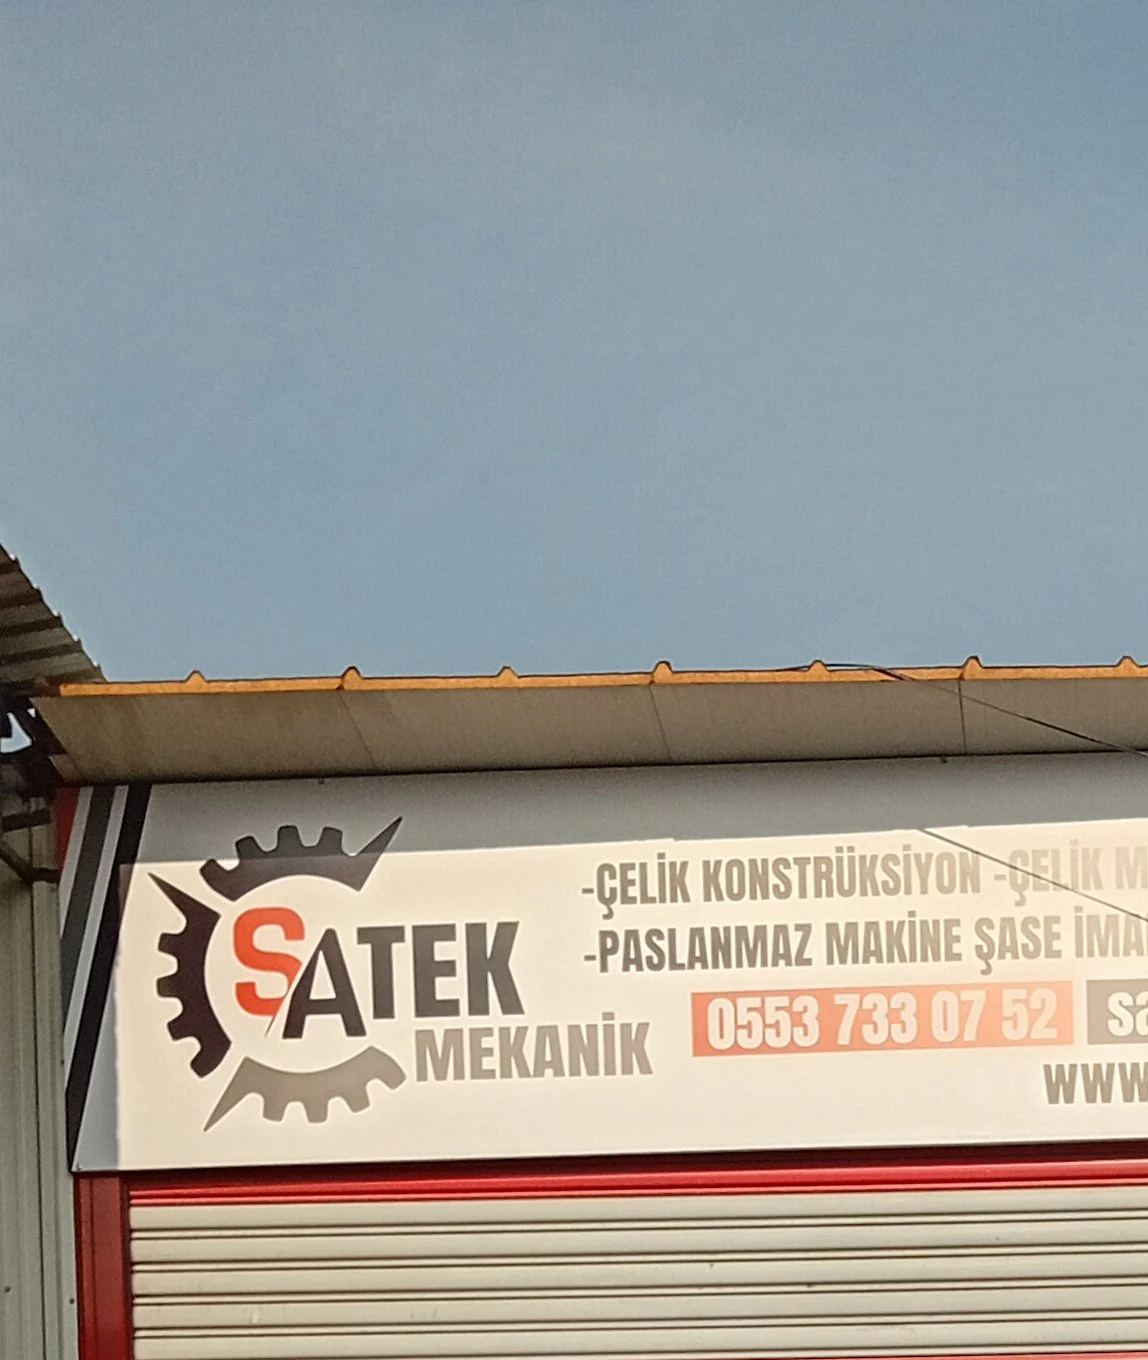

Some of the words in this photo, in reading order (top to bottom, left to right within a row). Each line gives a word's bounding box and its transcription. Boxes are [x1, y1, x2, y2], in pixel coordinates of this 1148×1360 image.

[582, 853, 689, 919] -ÇELİK
[703, 844, 981, 901] KONSTRÜKSİYON
[233, 906, 525, 1039] SATEK
[584, 923, 813, 973] -PASLANMAZ
[825, 911, 962, 967] MAKİNE
[975, 915, 1062, 975] ŞASE
[415, 1011, 653, 1082] MEKANİK
[707, 996, 819, 1050] 0553
[834, 993, 917, 1046] 733
[931, 990, 986, 1042] 07
[1001, 987, 1058, 1039] 52
